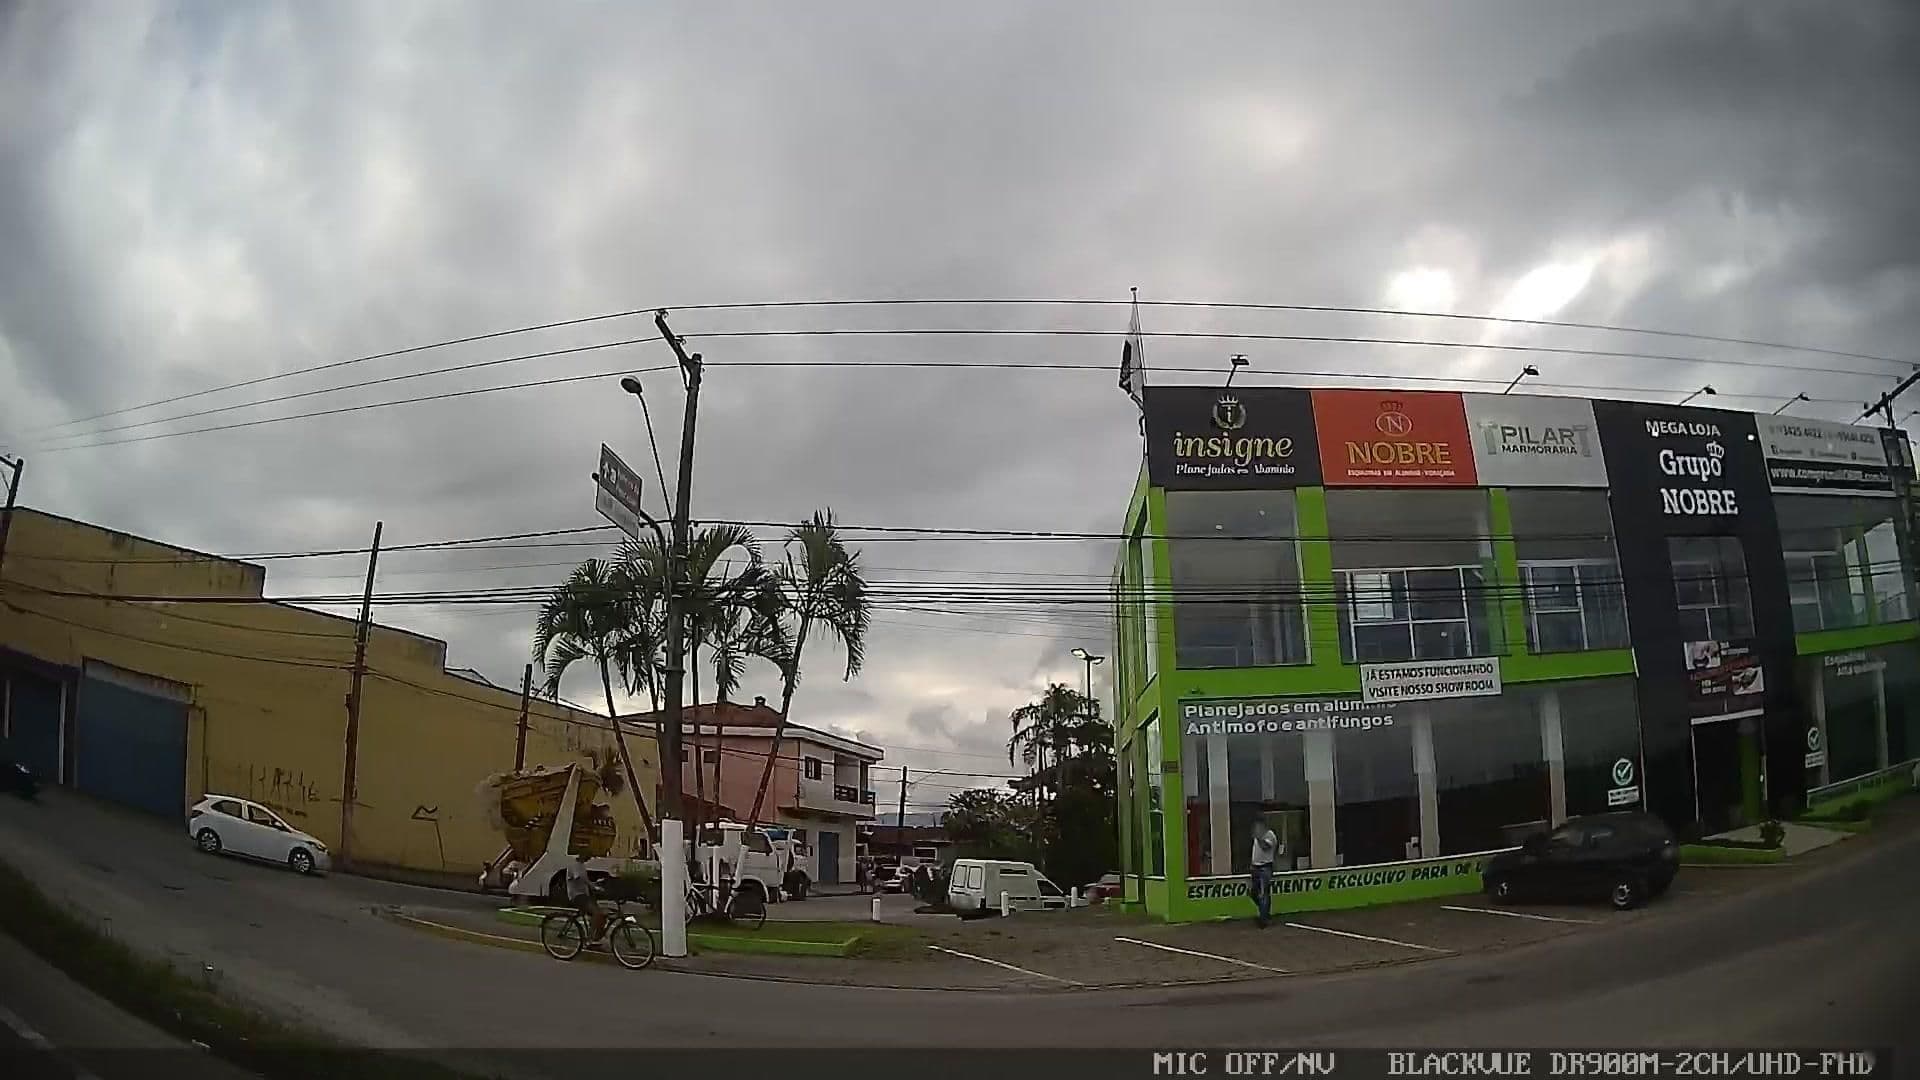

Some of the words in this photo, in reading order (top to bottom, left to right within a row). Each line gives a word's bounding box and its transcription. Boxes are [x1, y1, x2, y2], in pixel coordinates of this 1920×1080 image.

[1384, 415, 1404, 433] N
[1646, 420, 1688, 437] MEGA
[1689, 422, 1721, 436] LOJA
[1500, 425, 1577, 446] PILAR
[1173, 431, 1294, 467] insigne
[1344, 441, 1452, 464] NOBRE
[1502, 444, 1578, 455] MARMORARIA
[1659, 449, 1722, 482] Grupo
[1660, 487, 1739, 515] NOBRE
[1378, 667, 1424, 680] ESTAMOS
[1424, 662, 1494, 678] FUNCIONANDO
[1368, 685, 1399, 698] VISITE
[1401, 683, 1434, 696] NOSSO
[1185, 702, 1290, 719] Planejados
[1293, 702, 1320, 714] em
[1186, 720, 1278, 736] Antimofo
[1281, 721, 1293, 732] e
[1295, 715, 1394, 730] antifungos
[1328, 869, 1406, 890] EXCLUSIVO
[1411, 865, 1448, 881] PARA
